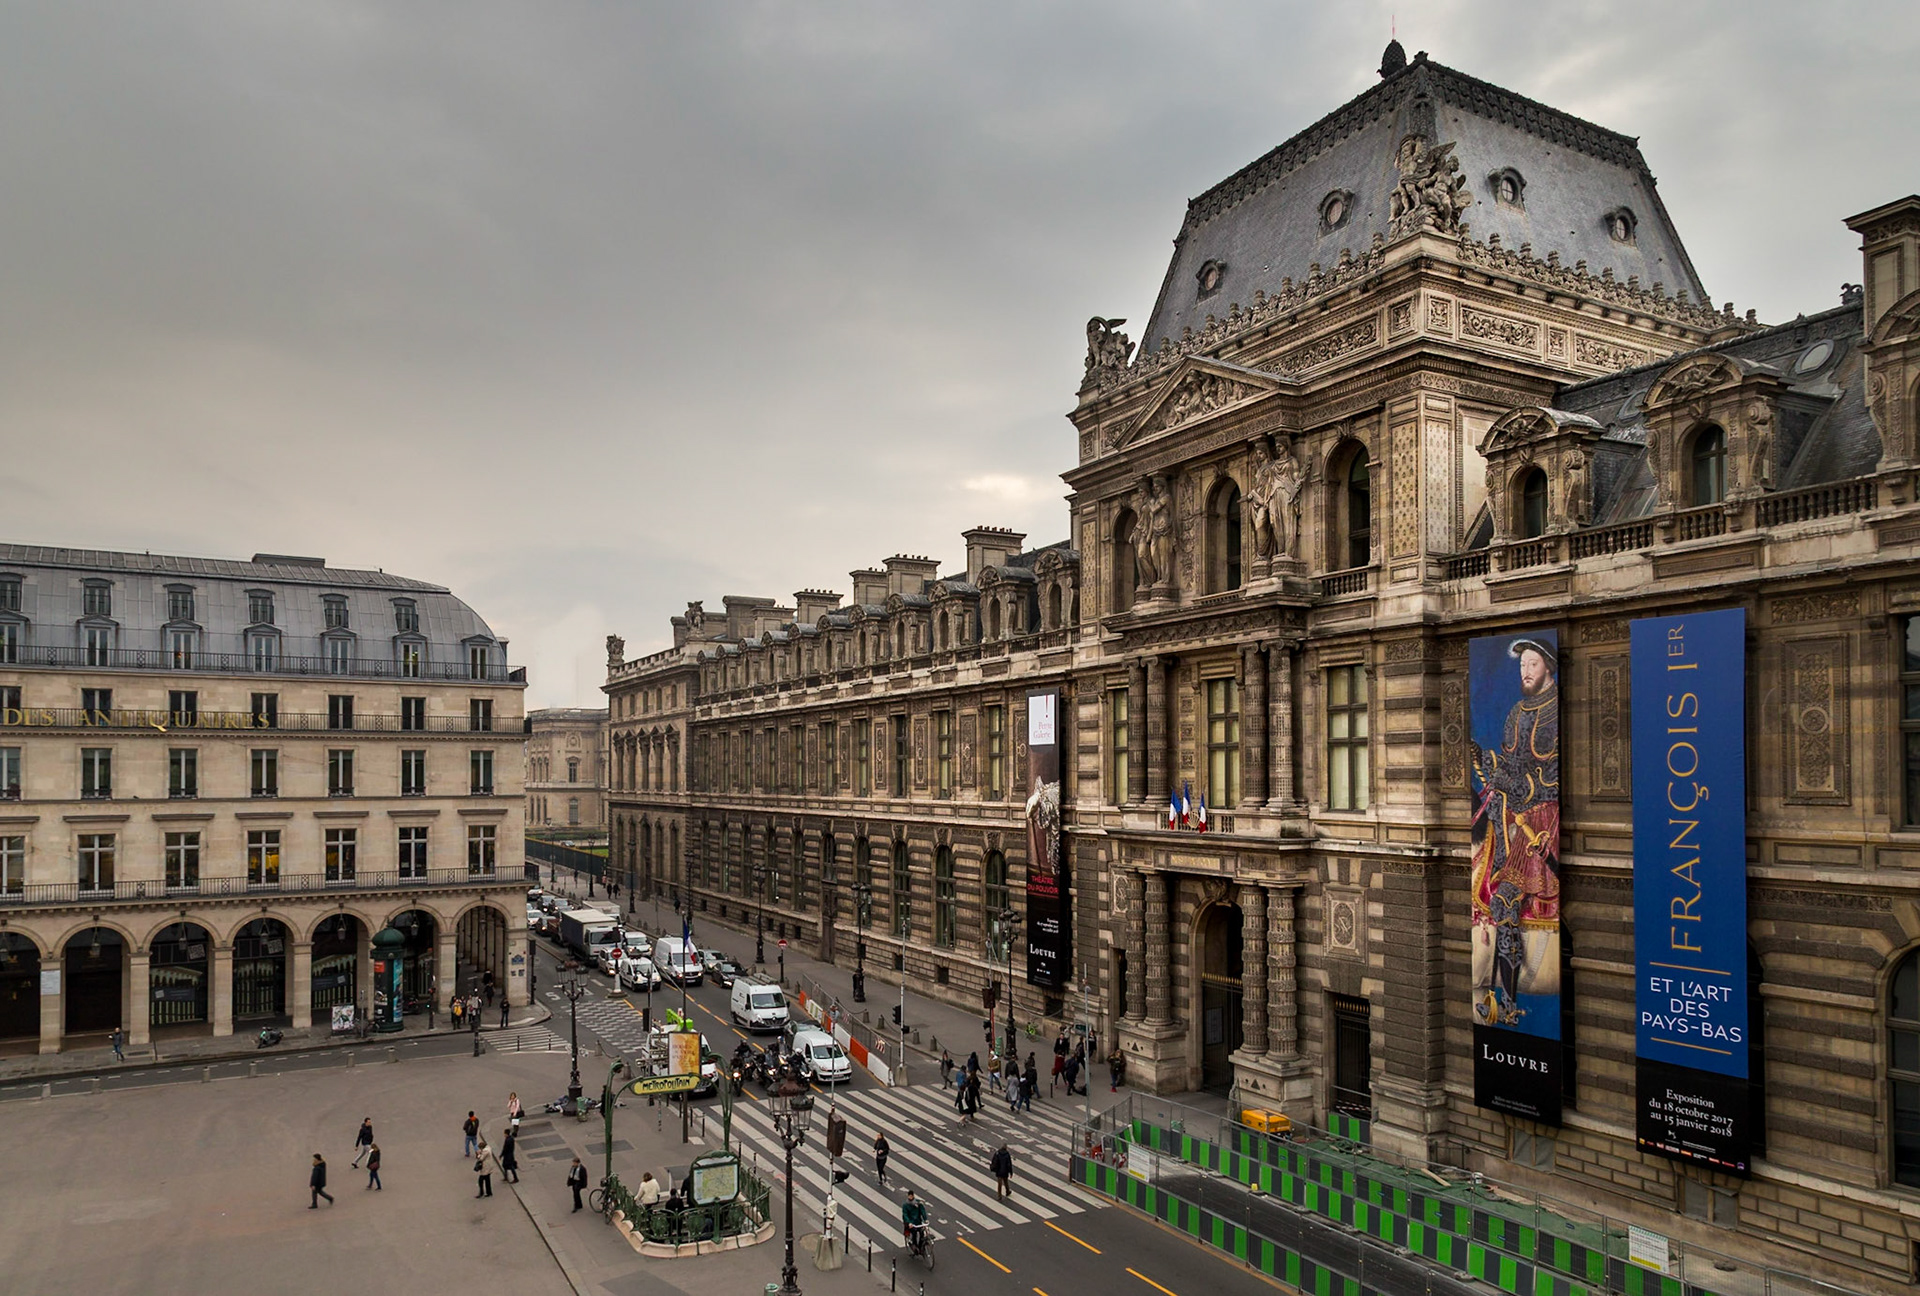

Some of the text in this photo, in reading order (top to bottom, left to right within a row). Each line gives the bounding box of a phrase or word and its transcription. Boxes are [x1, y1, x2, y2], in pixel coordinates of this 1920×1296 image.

[76, 709, 270, 732] ANTIQUAIRES
[1666, 692, 1709, 953] FRANÇOIS
[1035, 884, 1060, 894] POUVOIR
[1650, 976, 1732, 1003] ET L'ART
[1670, 998, 1710, 1018] DES
[1642, 1011, 1742, 1043] PAYS-BAS
[643, 1078, 690, 1091] METROPOLITAIN
[1666, 1088, 1715, 1109] Exposition
[1649, 1098, 1734, 1128] du 18 octobre 2017
[1650, 1111, 1733, 1137] au 15 janvier 2018
